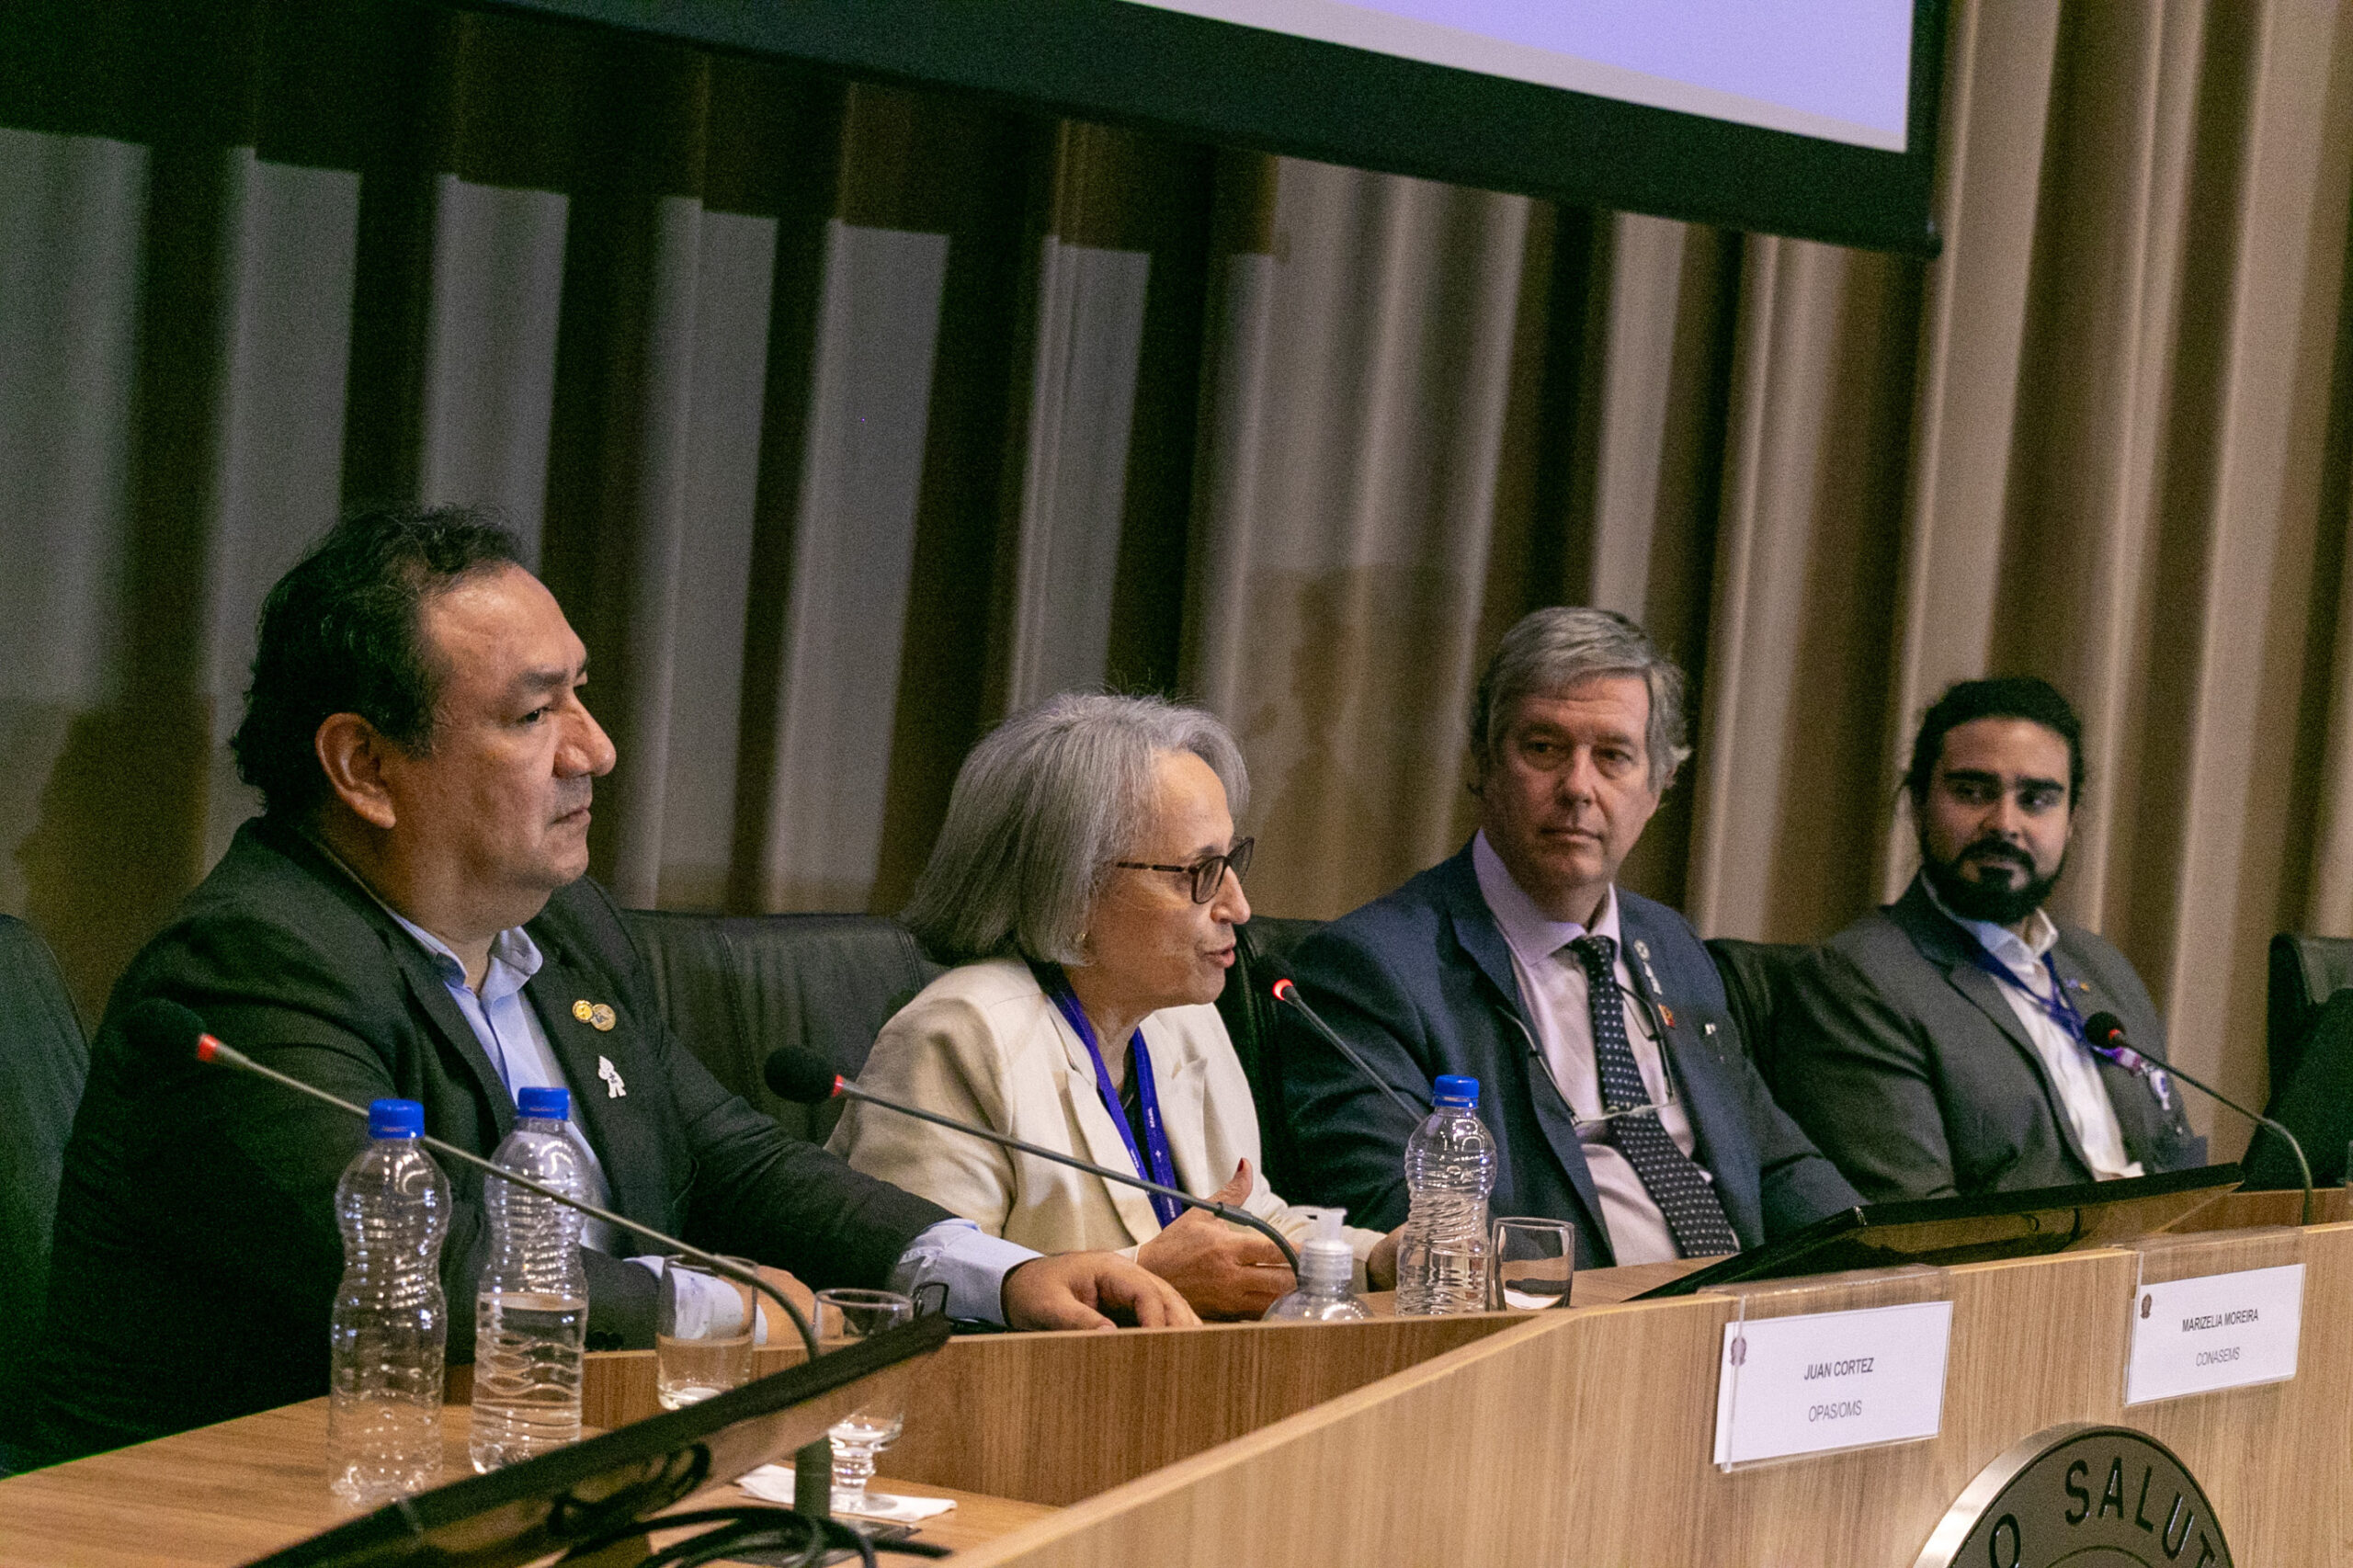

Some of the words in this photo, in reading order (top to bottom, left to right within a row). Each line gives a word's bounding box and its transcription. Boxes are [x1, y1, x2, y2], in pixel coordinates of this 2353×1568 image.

[2182, 1314, 2222, 1332] MARIZELIA
[2224, 1309, 2258, 1325] MOREIRA
[2196, 1346, 2240, 1367] CONASEMS
[1804, 1362, 1832, 1380] JUAN
[1834, 1358, 1874, 1377] CORTEZ
[1809, 1400, 1862, 1422] OPAS/OMS
